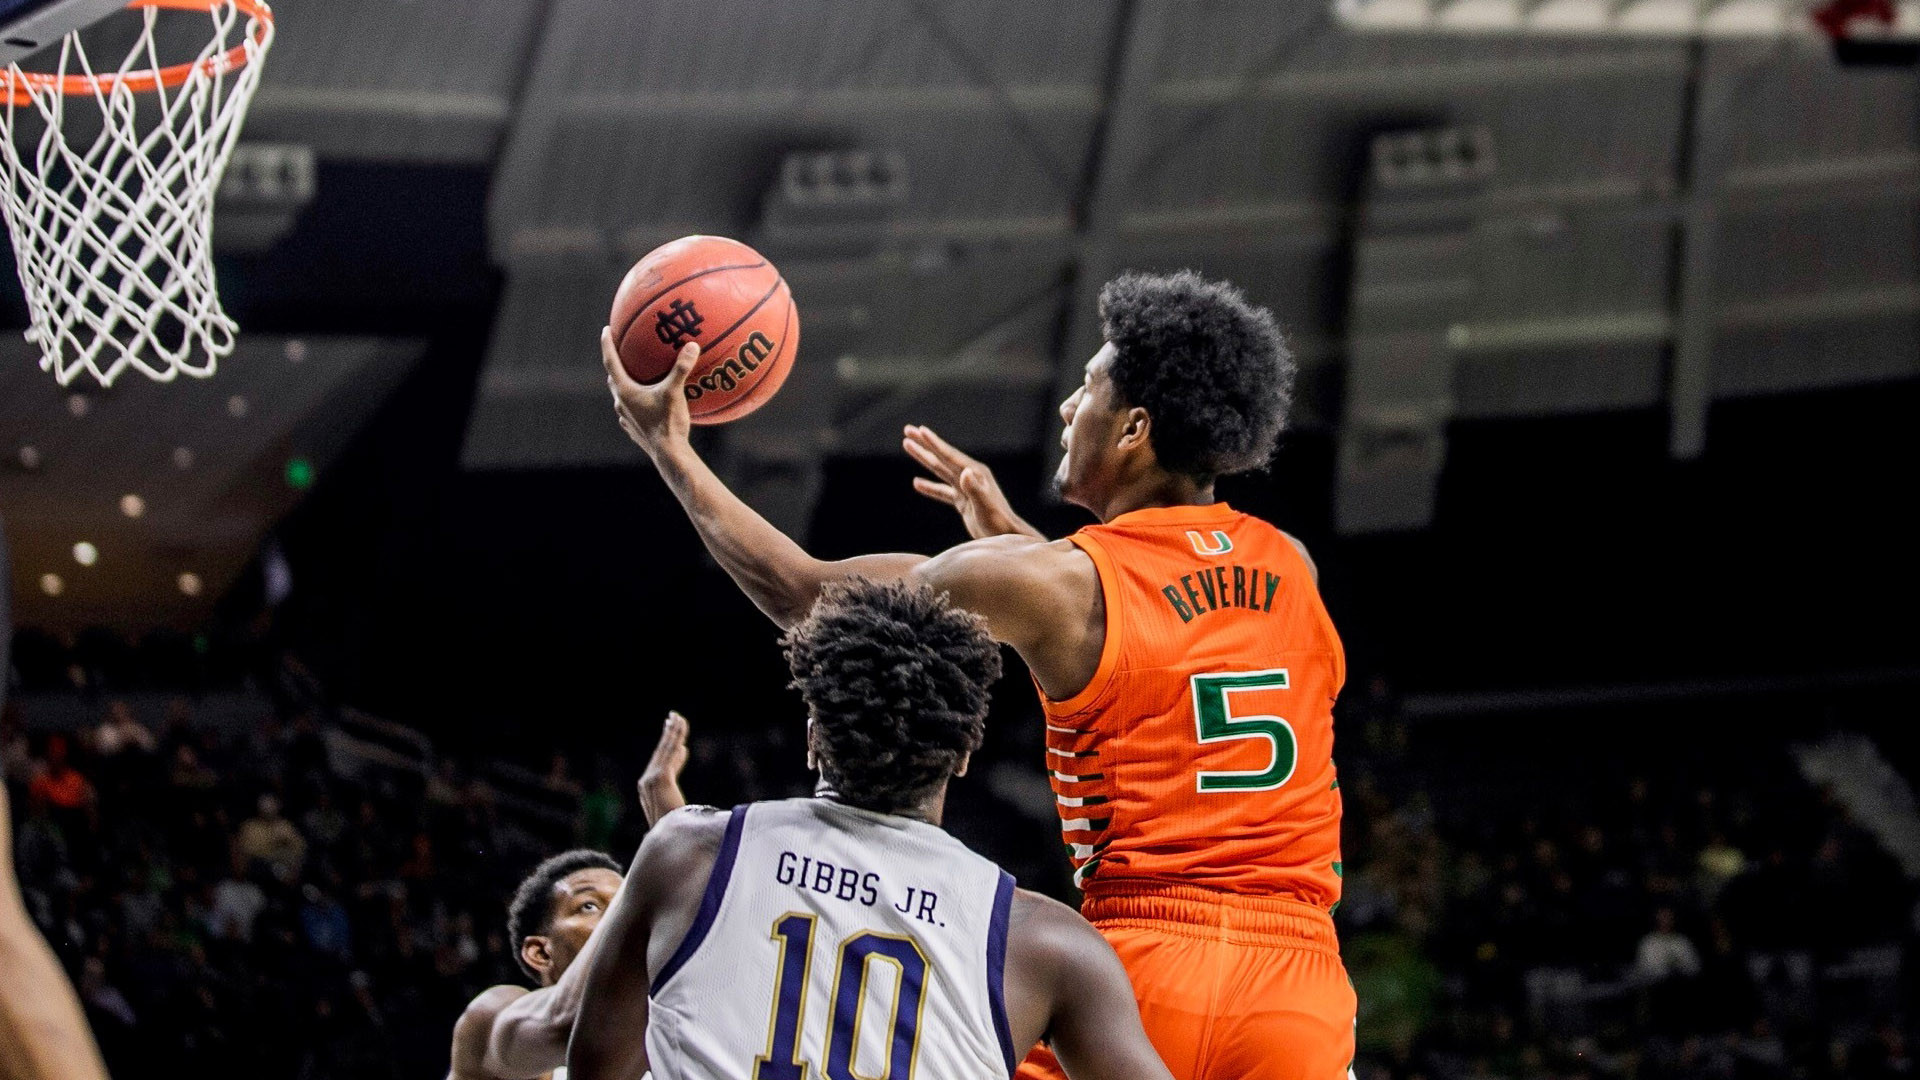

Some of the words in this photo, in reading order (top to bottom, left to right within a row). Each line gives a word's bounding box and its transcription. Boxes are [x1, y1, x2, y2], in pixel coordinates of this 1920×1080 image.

[684, 330, 775, 401] Wilso
[1186, 530, 1234, 556] U
[1162, 565, 1281, 624] BEVERLY
[1190, 668, 1298, 793] 5
[776, 851, 881, 907] GIBBS
[895, 886, 945, 928] JR.
[752, 910, 931, 1080] 10
